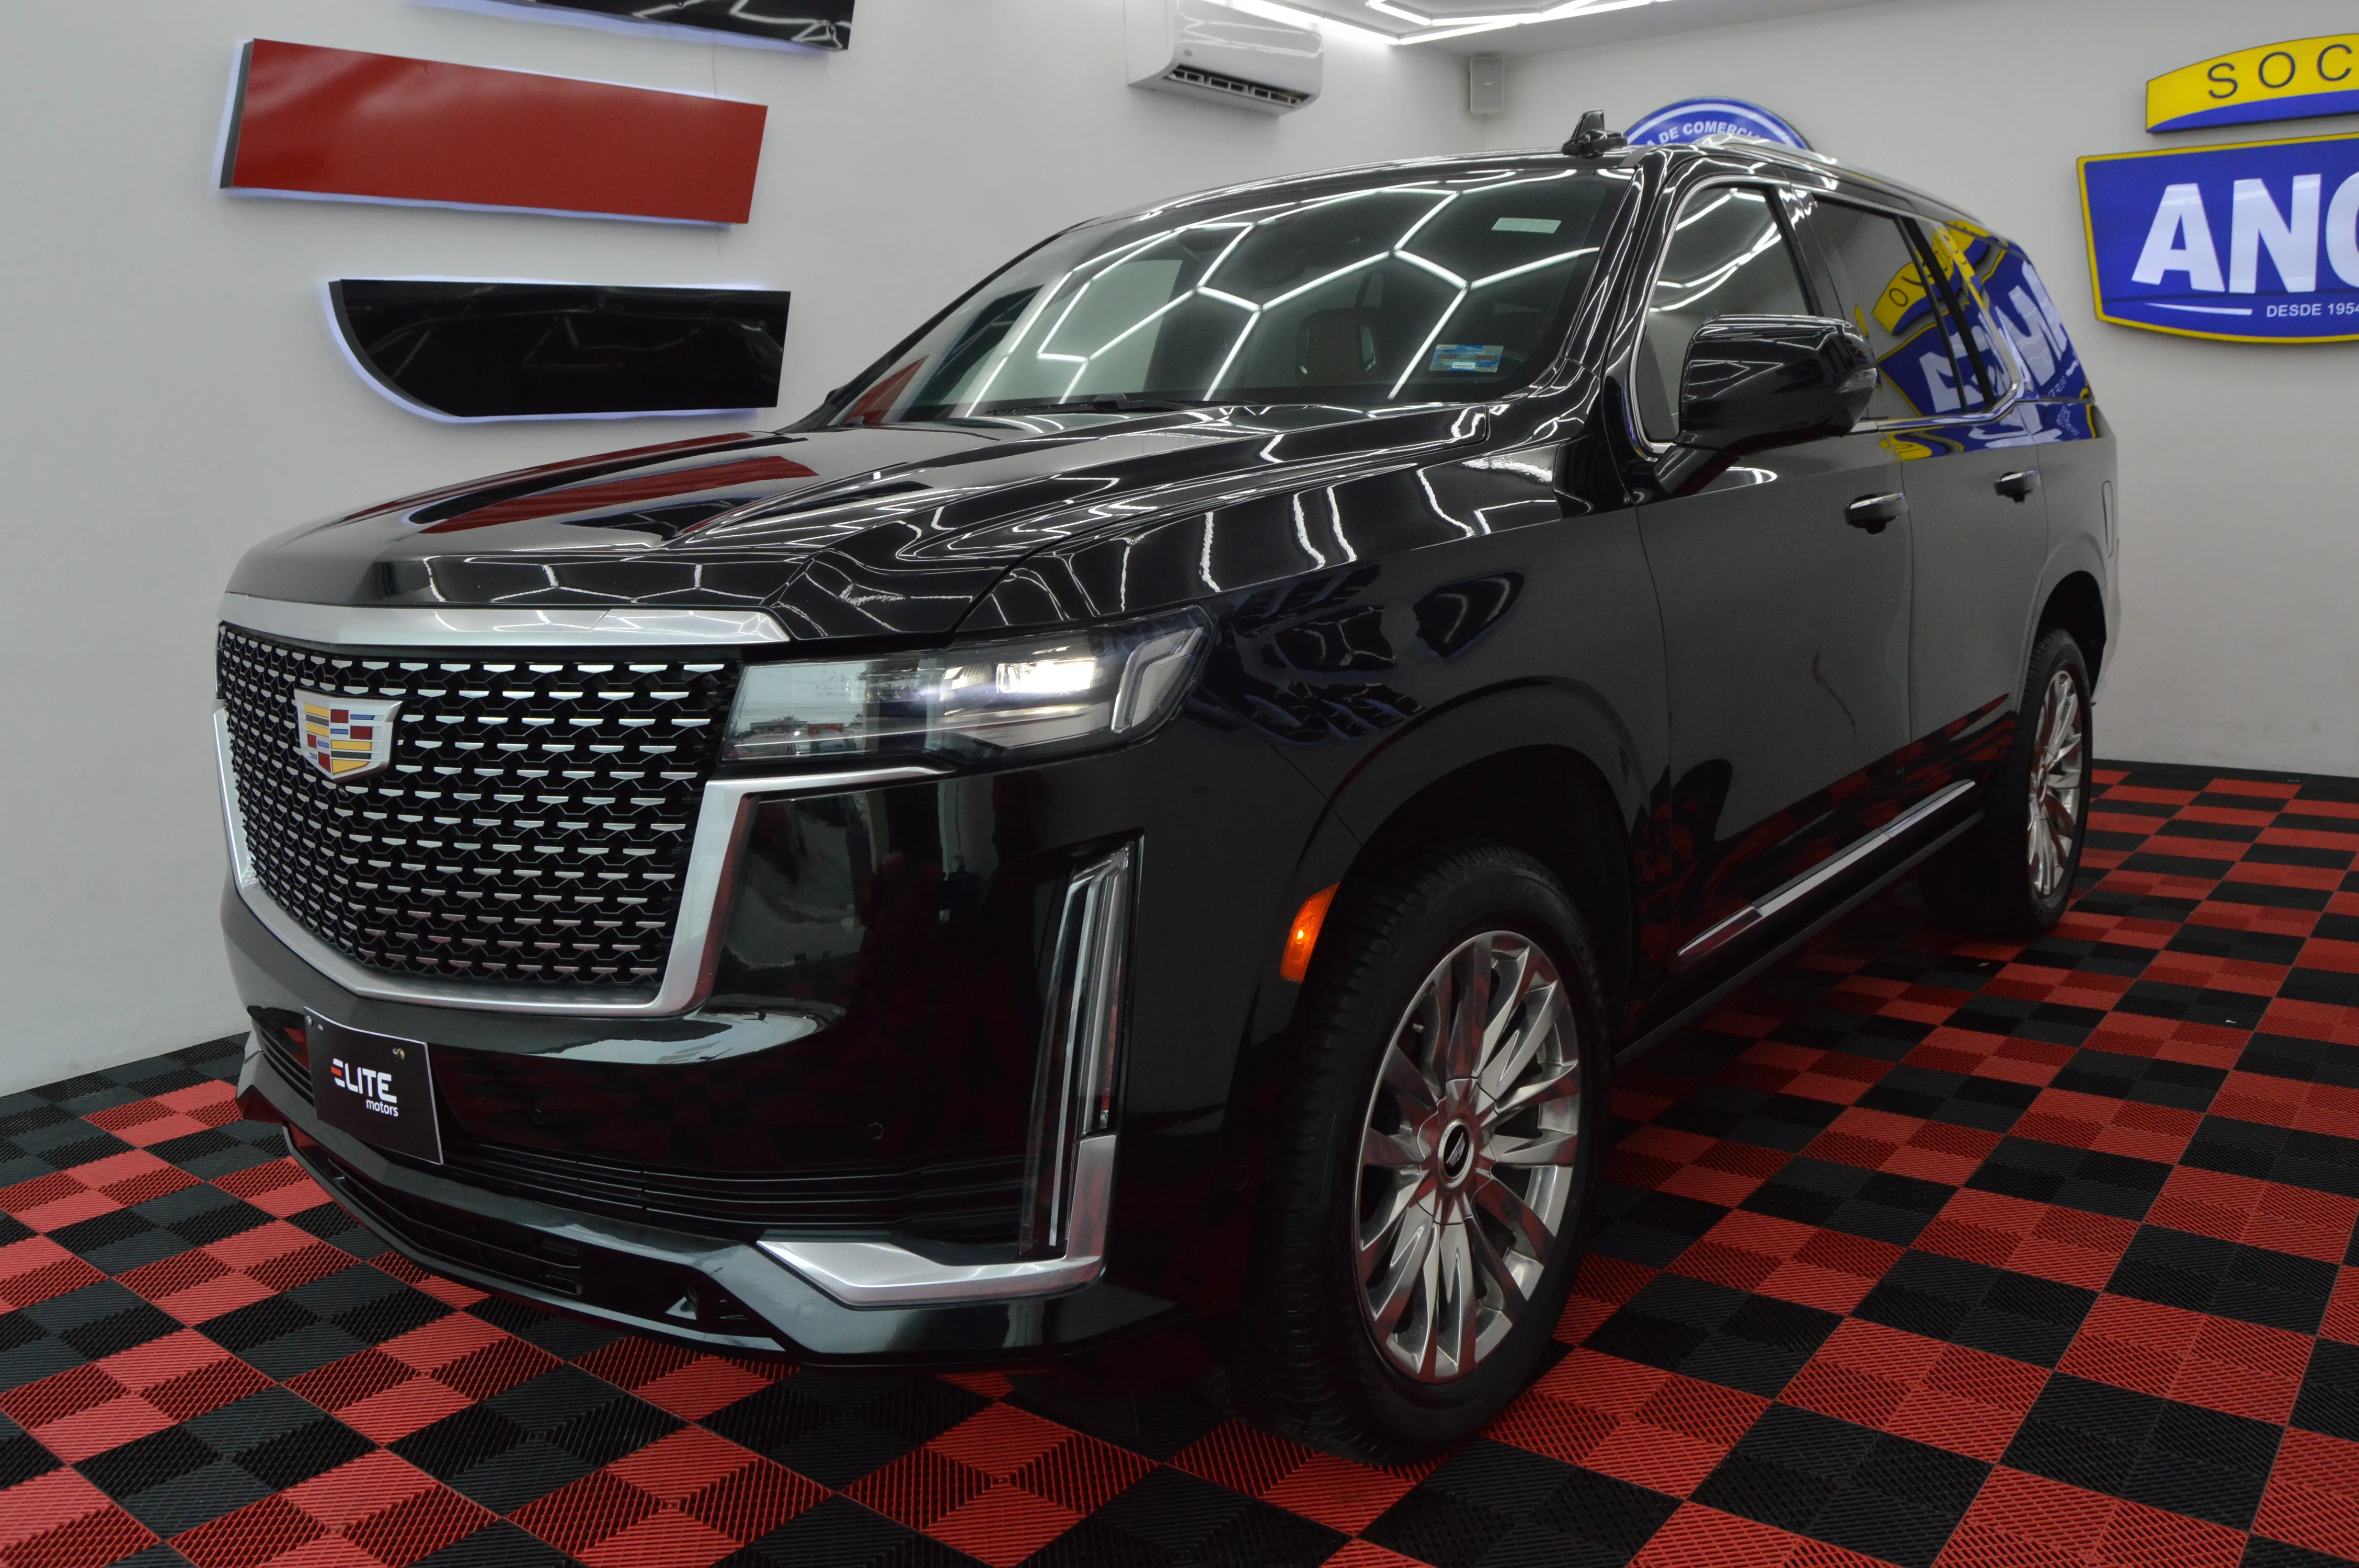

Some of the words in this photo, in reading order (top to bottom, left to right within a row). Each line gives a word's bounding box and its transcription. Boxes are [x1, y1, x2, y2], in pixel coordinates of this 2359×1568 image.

[2207, 44, 2352, 99] SOC
[1658, 126, 1680, 145] DE
[2266, 303, 2322, 317] DESDE
[331, 1058, 397, 1103] ELITE
[367, 1099, 398, 1117] motors
